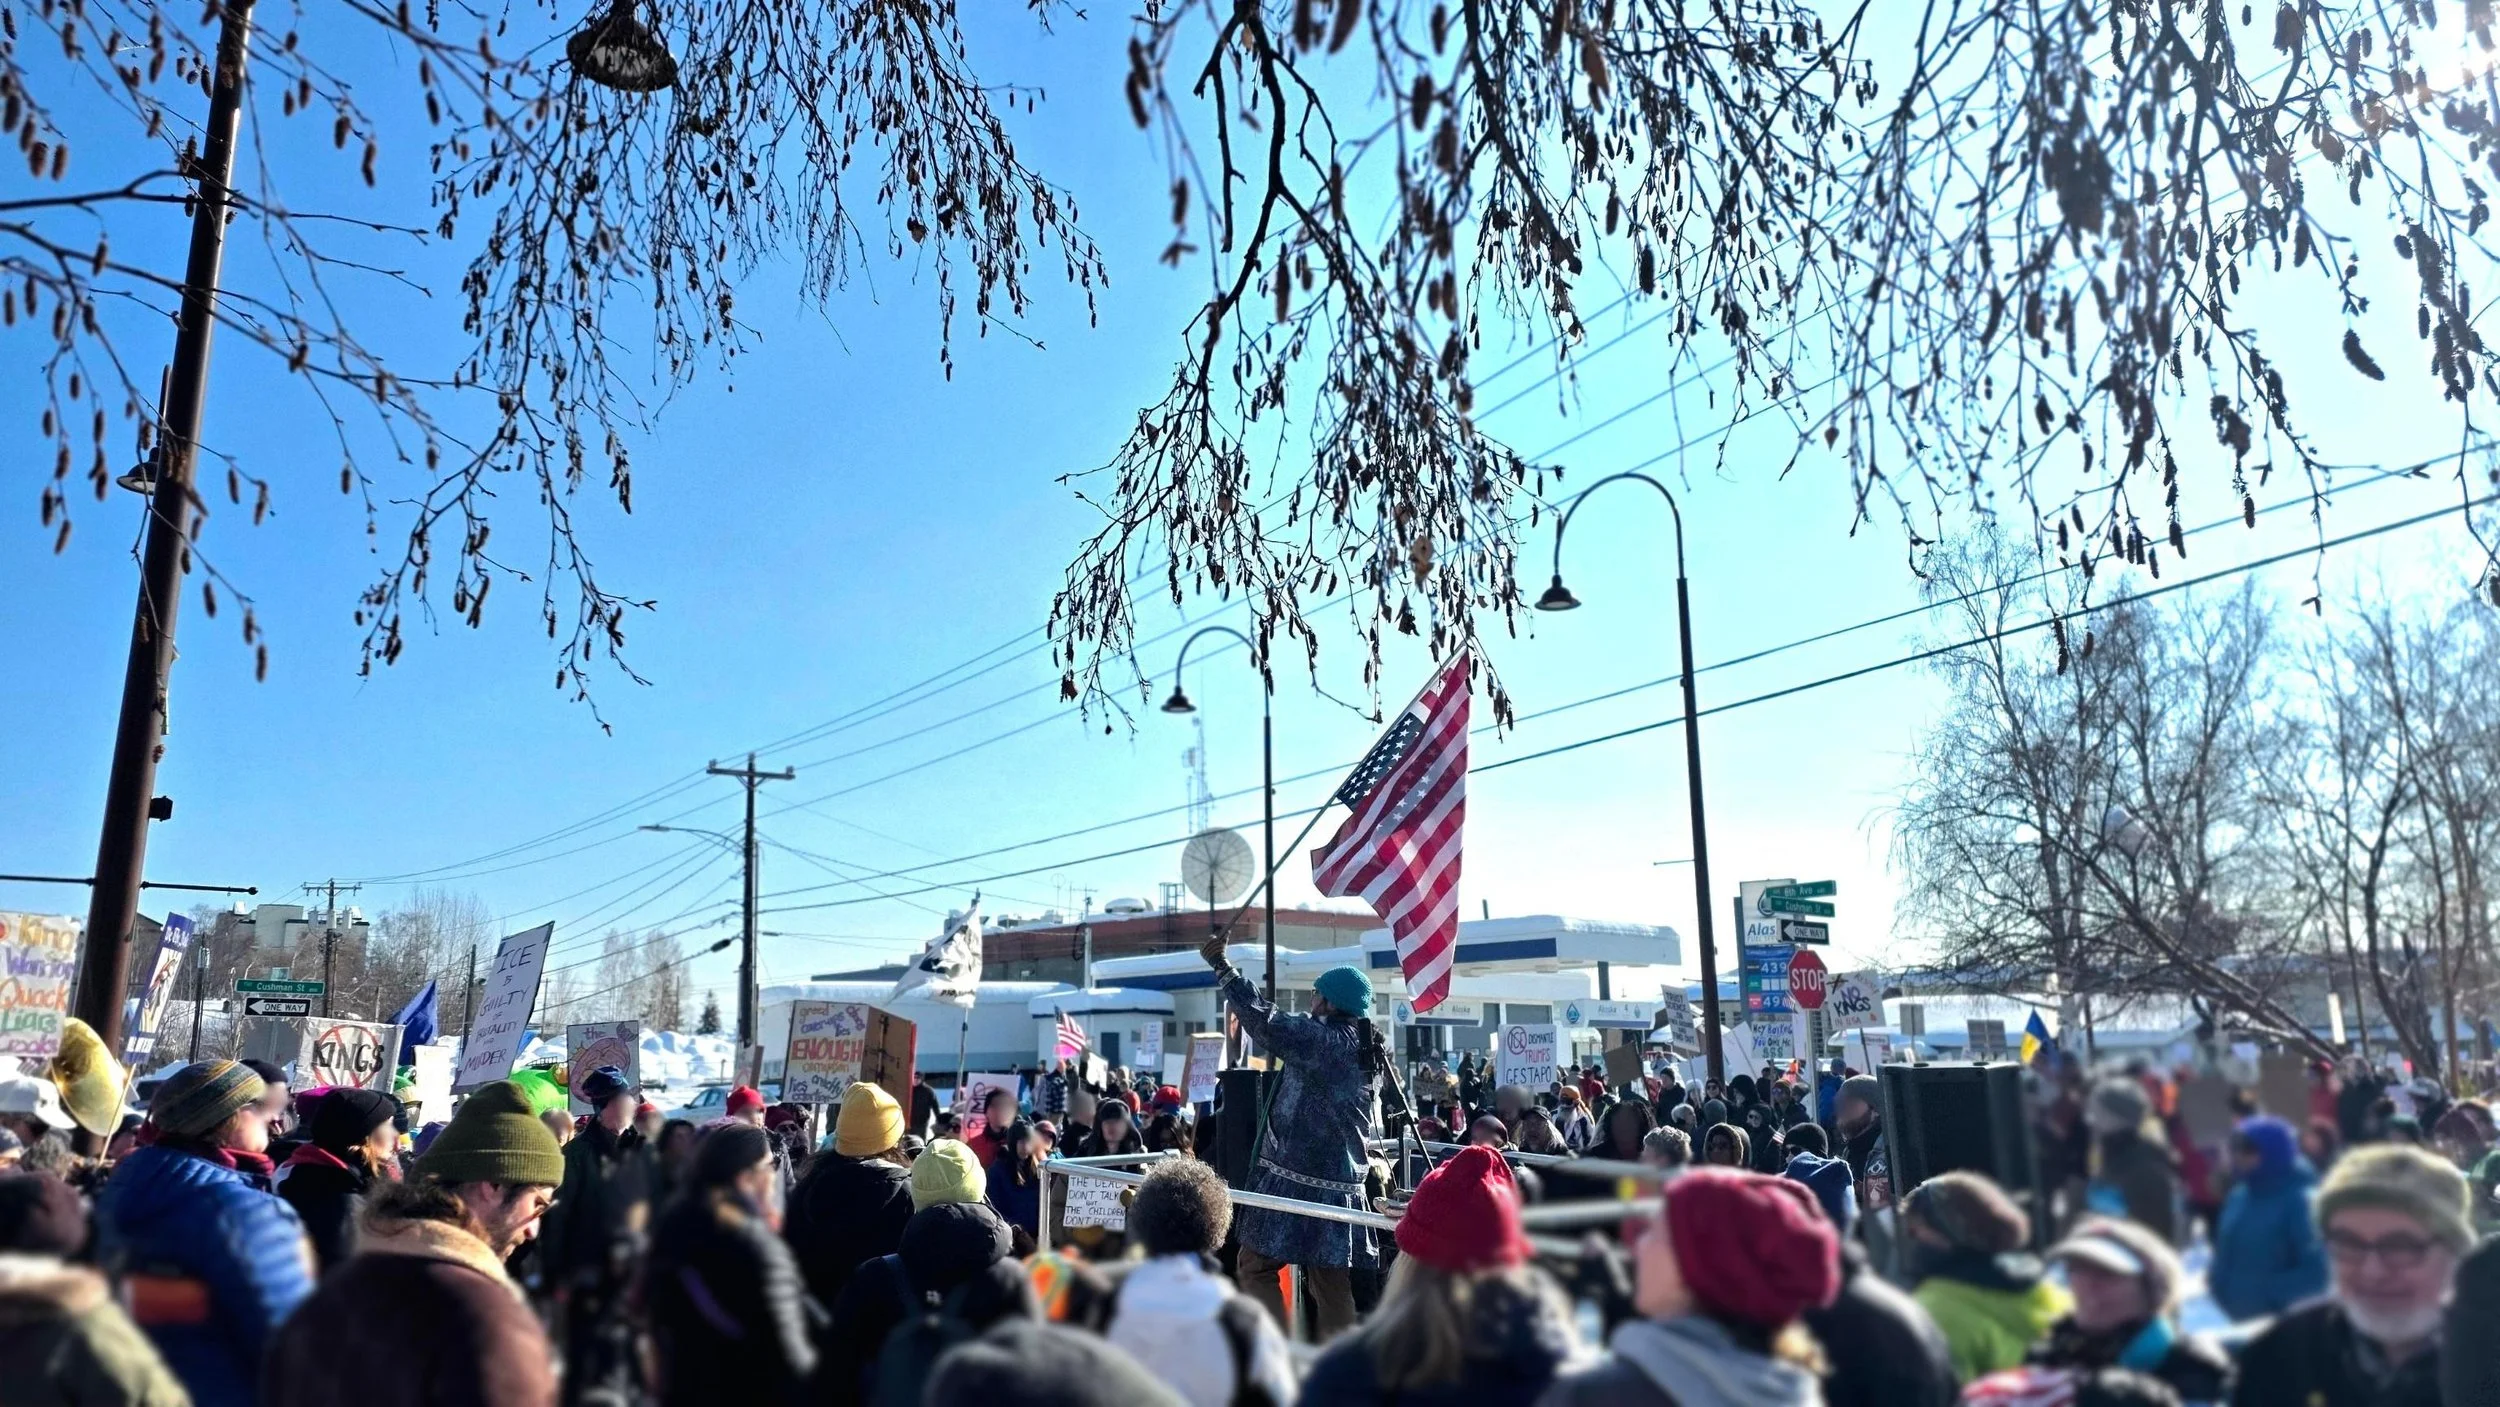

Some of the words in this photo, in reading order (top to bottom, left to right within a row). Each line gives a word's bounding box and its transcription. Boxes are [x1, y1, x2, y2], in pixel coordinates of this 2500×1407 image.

[1784, 887, 1797, 897] 6th
[1800, 887, 1813, 895] Ave
[1785, 901, 1813, 913] Cushman
[1747, 923, 1776, 936] Alas
[1794, 927, 1808, 937] ONE
[1810, 928, 1825, 938] WAY
[497, 944, 536, 973] ICE
[1791, 968, 1825, 991] STOP
[256, 982, 293, 991] Cushman
[296, 984, 305, 992] St
[1841, 986, 1860, 1000] NO
[264, 1003, 282, 1011] ONE
[480, 987, 531, 1016] GUILTY
[1834, 997, 1871, 1017] KINGS
[799, 1004, 829, 1024] greed
[312, 1040, 384, 1073] KINGS
[792, 1038, 864, 1062] ENOUGH
[463, 1049, 507, 1073] MURDER
[1505, 1066, 1551, 1085] GESTAPO
[1071, 1177, 1088, 1187] THE
[1069, 1190, 1096, 1200] DONT
[1101, 1190, 1119, 1200] TALK
[1065, 1206, 1082, 1214] THE
[1089, 1207, 1125, 1216] CHILDREN
[1065, 1216, 1091, 1224] DONT
